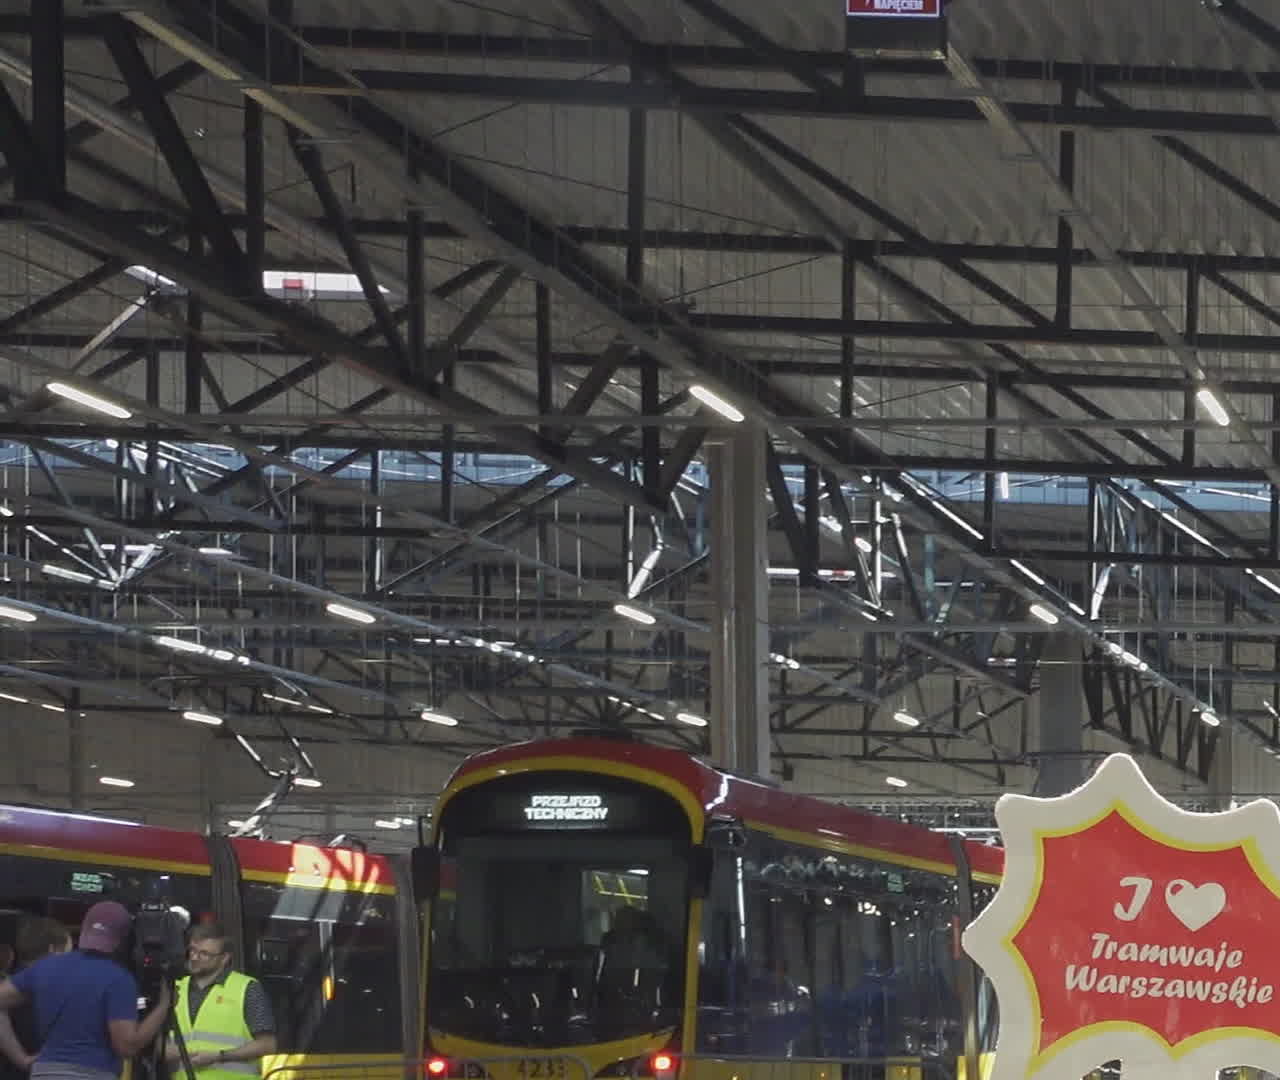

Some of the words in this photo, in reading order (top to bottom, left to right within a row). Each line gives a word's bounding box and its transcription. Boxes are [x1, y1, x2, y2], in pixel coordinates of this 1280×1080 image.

[524, 807, 608, 820] TECHNICZNY
[1091, 932, 1244, 973] Tramwaje
[1064, 964, 1274, 1009] Warszawskie
